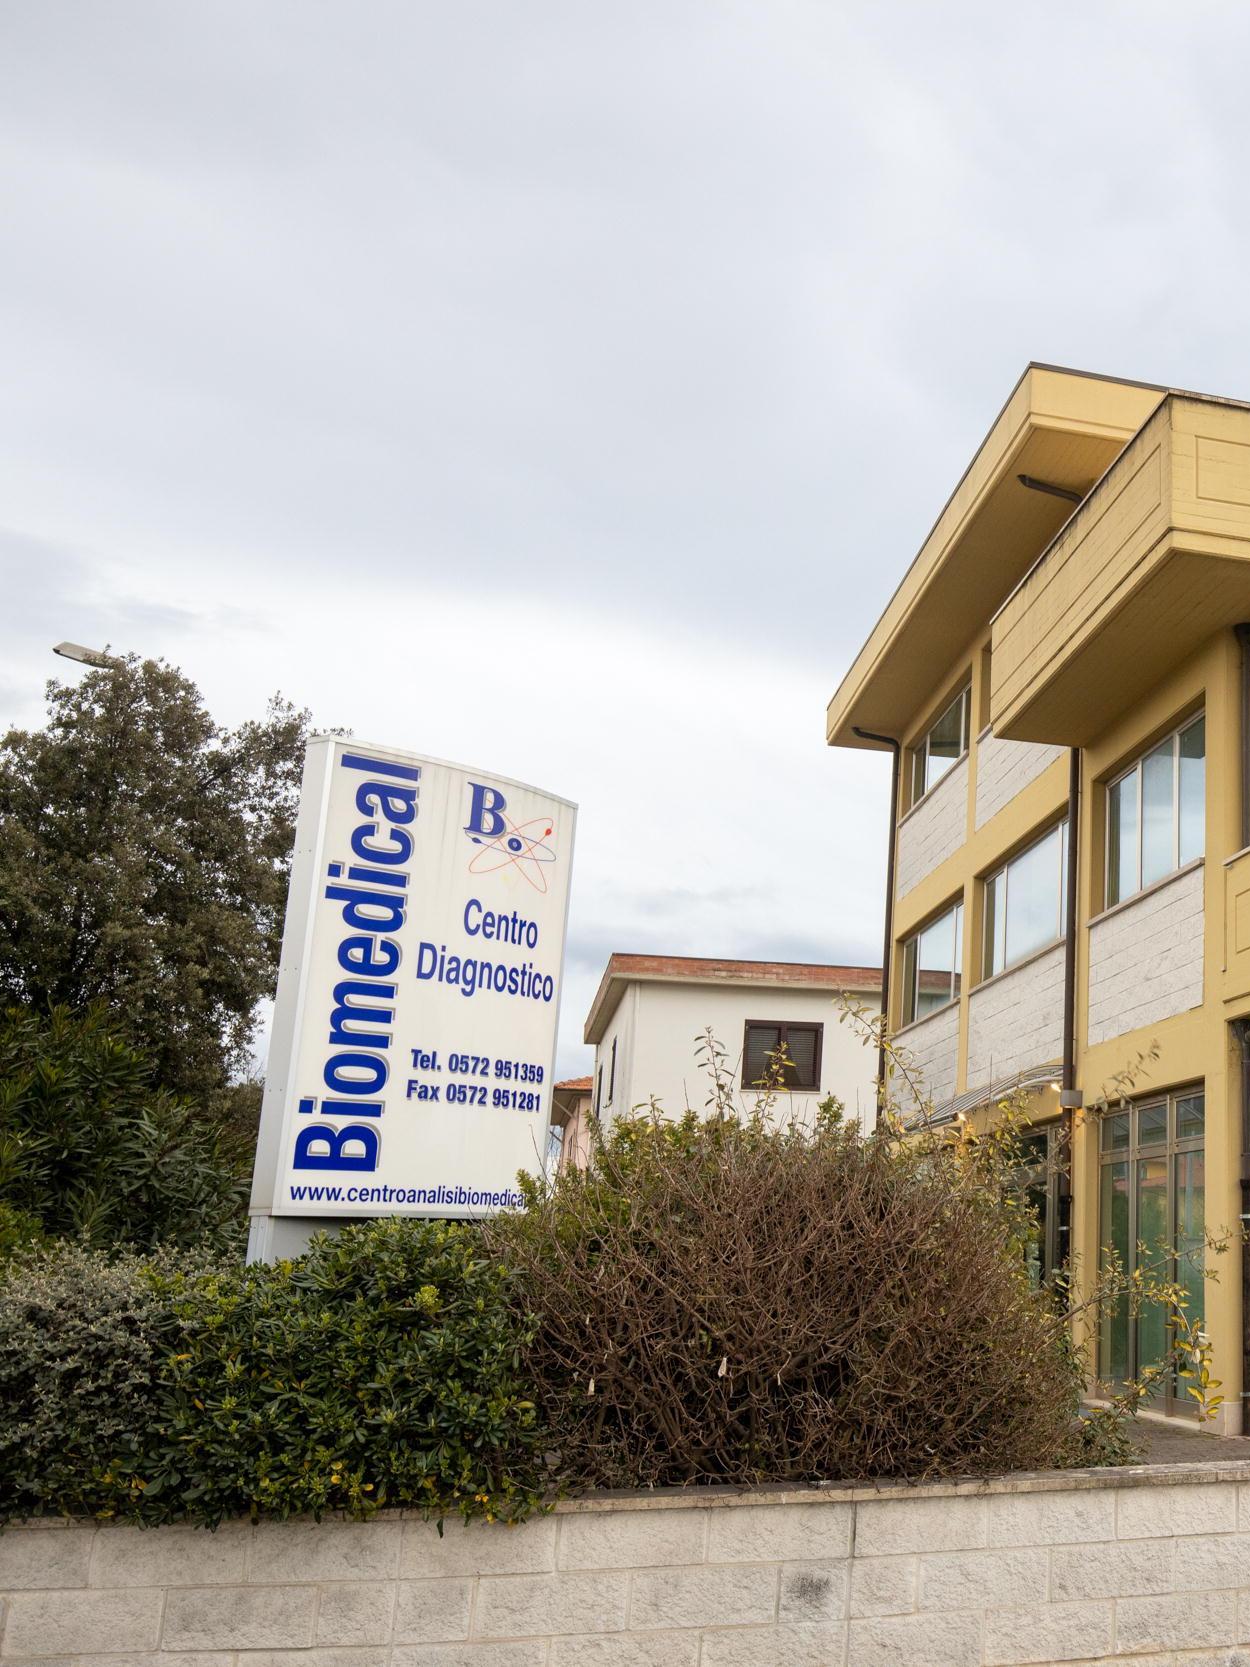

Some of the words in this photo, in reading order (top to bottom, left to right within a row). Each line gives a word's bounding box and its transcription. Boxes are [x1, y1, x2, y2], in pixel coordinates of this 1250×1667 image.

[463, 781, 507, 838] B
[463, 898, 538, 949] Centro
[293, 752, 421, 1172] Biomedical
[416, 941, 554, 1002] Diagnostico
[411, 1048, 441, 1071] Tel.
[448, 1053, 491, 1077] 0572
[494, 1059, 545, 1084] 951359
[406, 1079, 440, 1102] Fax
[445, 1083, 488, 1106] 0572
[492, 1088, 542, 1112] 951281
[290, 1184, 525, 1208] www.centroanalisibiomedica
